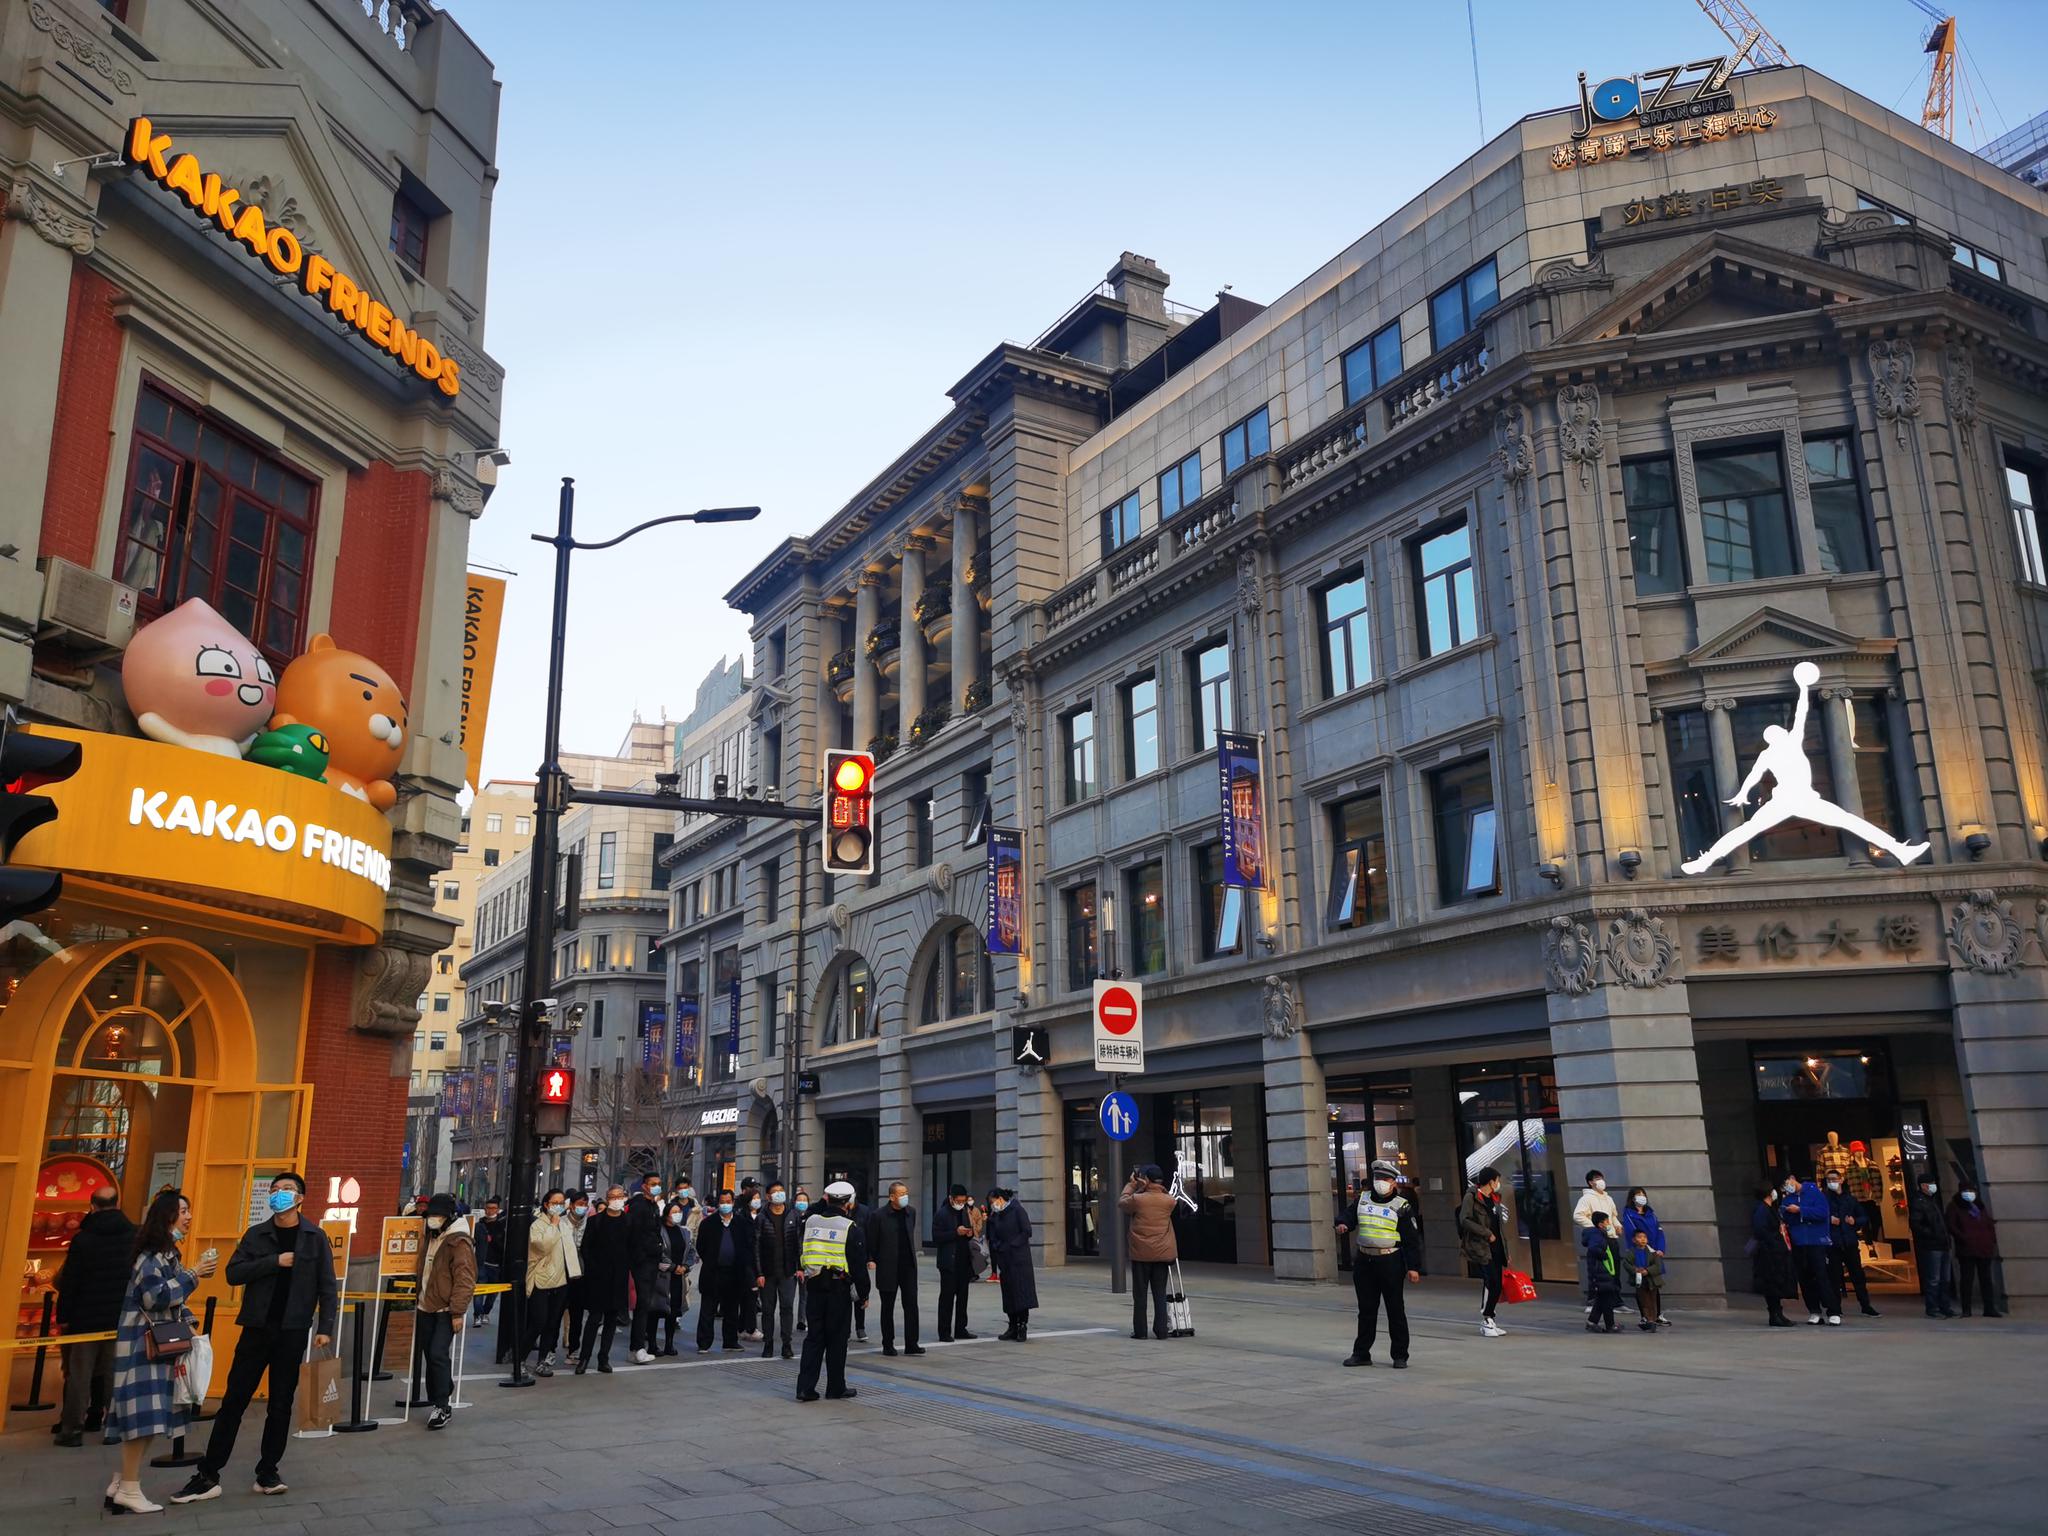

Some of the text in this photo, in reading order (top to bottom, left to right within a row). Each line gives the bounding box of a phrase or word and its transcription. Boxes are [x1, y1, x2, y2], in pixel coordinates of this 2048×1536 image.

[1571, 55, 1732, 138] jazz
[1640, 96, 1734, 126] SHANGHAI
[1552, 106, 1778, 165] 林肯爵士乐上海中心
[130, 116, 461, 396] KAKAO FRIENDS
[463, 586, 484, 661] KAKAO
[129, 787, 391, 892] KAKAO FRIENDS
[1220, 768, 1232, 858] THE CENTRAL
[1696, 914, 1920, 963] 美伦大楼
[701, 1108, 739, 1126] SKECHE
[327, 1176, 341, 1203] I
